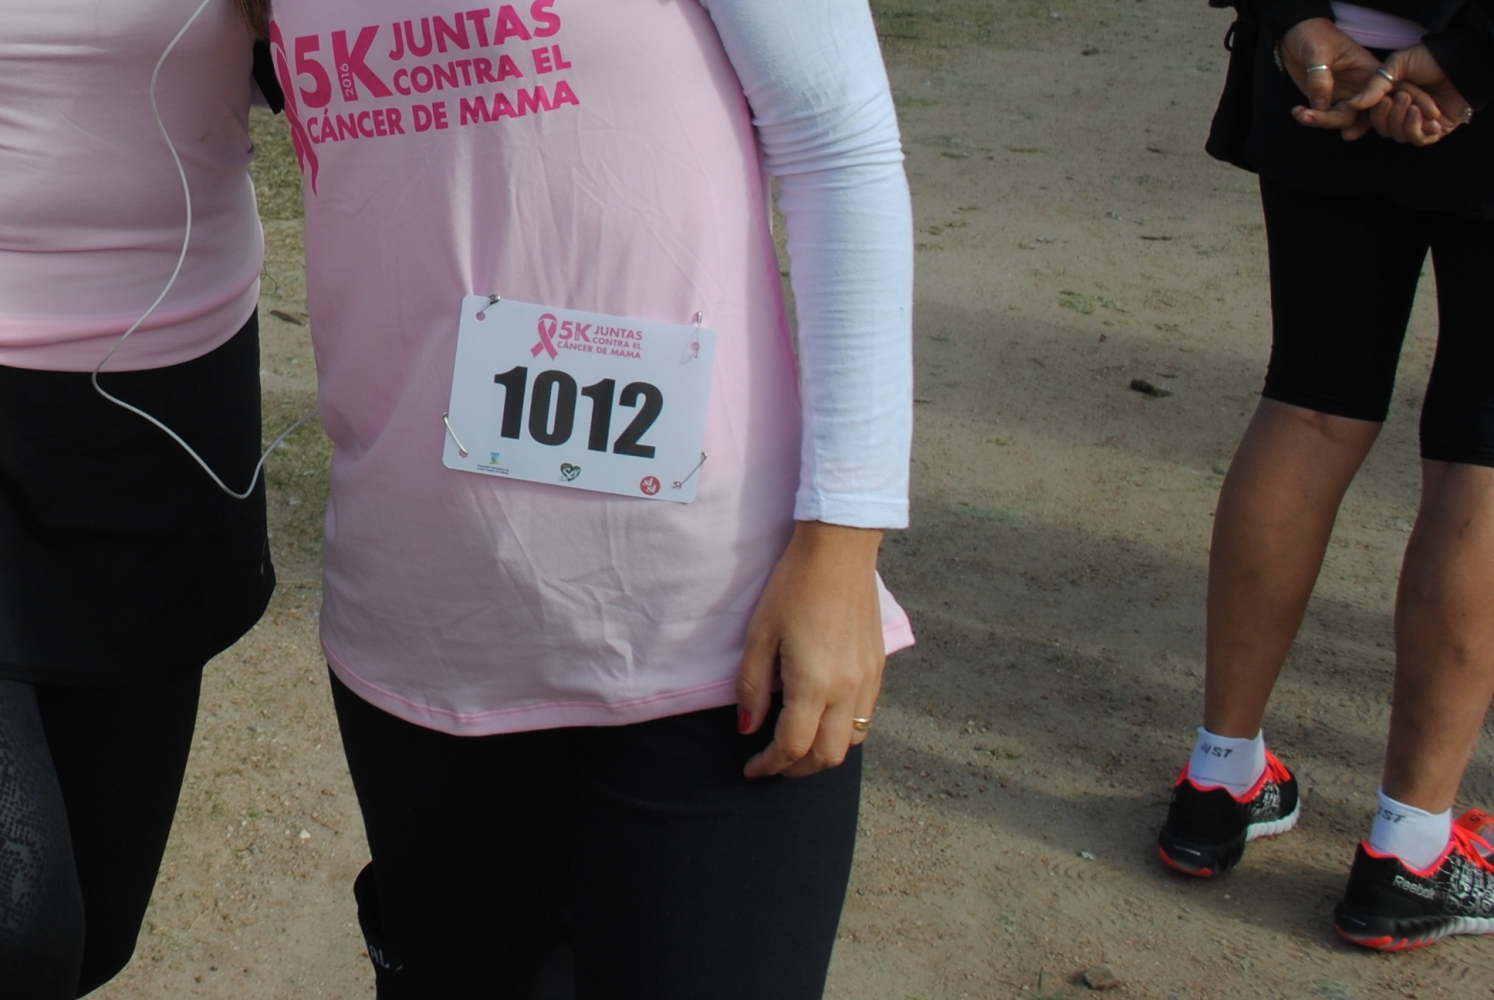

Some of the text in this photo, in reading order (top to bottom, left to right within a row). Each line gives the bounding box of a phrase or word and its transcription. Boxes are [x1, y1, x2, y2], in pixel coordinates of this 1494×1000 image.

[295, 25, 394, 109] 5K
[343, 63, 355, 97] 2016
[393, 44, 572, 96] CONTRA EL
[307, 80, 580, 144] CÁNCER DE MAMA
[558, 320, 592, 343] 5K
[592, 337, 642, 350] CONTRA EL
[594, 325, 643, 341] JUNTAS
[557, 339, 641, 359] CÁNCER DE MAMA
[493, 365, 664, 459] 1012
[1392, 874, 1436, 900] Reebok
